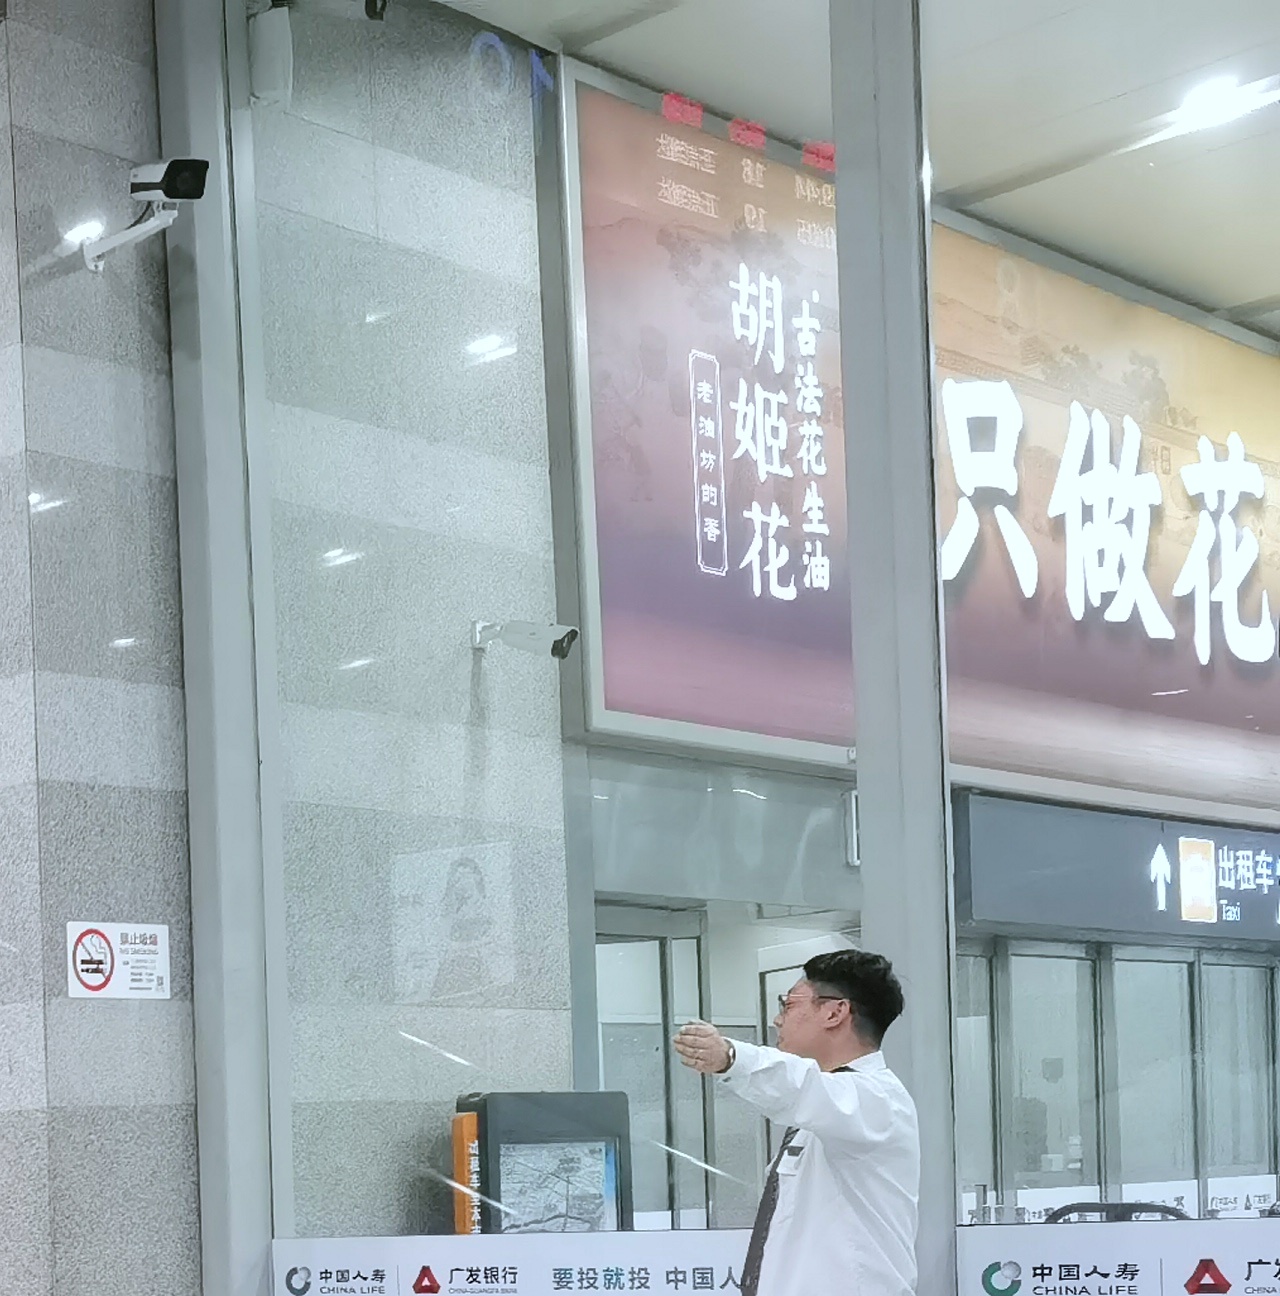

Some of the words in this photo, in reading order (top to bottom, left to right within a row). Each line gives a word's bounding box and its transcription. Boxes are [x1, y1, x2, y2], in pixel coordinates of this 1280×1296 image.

[729, 262, 797, 601] 胡姬花
[791, 291, 831, 591] 古法花生油
[696, 379, 721, 543] 老油坊的香
[941, 378, 1275, 665] 只做花
[1218, 845, 1280, 895] 出租车
[1220, 899, 1240, 921] Taxi
[319, 1268, 386, 1283] 中国人寿
[448, 1266, 518, 1285] 广发银行
[552, 1267, 651, 1291] 要投就投
[1032, 1262, 1140, 1282] 中国人寿
[319, 1286, 357, 1295] CHINA
[360, 1286, 386, 1295] LIFE
[1032, 1285, 1091, 1296] CHINA
[1097, 1285, 1139, 1296] LIFE
